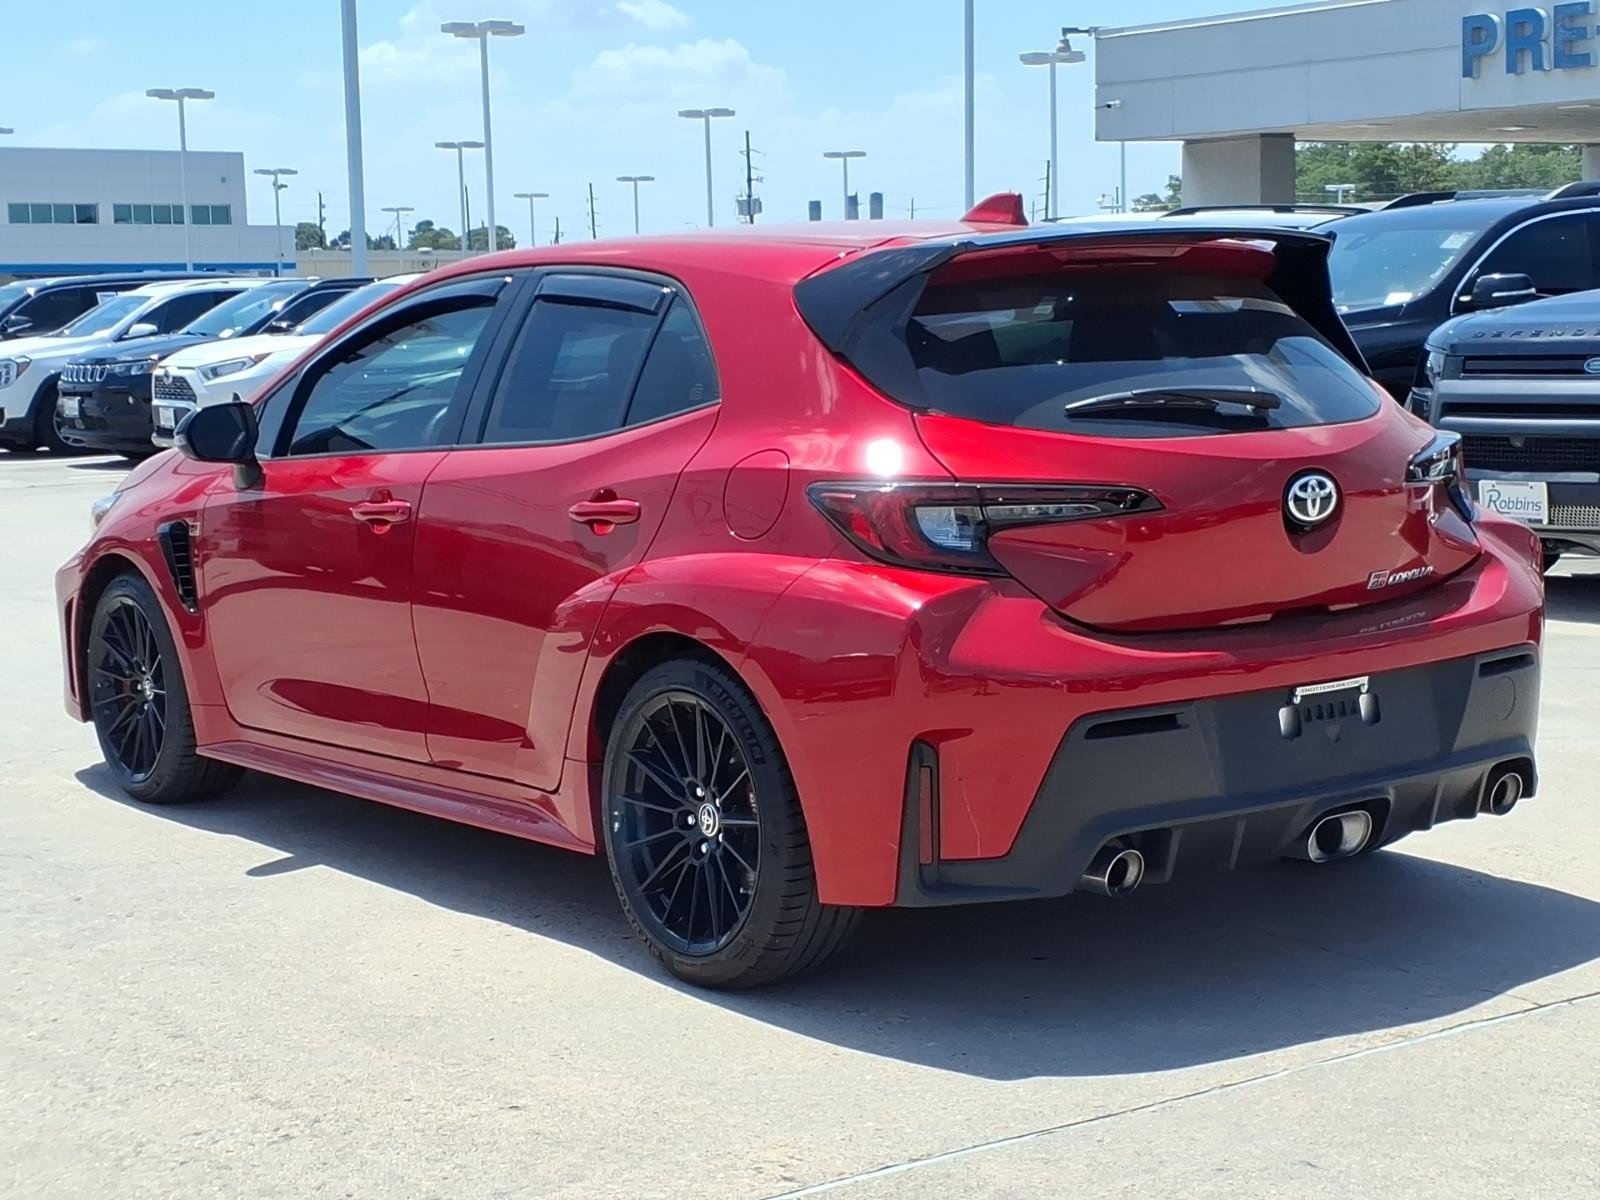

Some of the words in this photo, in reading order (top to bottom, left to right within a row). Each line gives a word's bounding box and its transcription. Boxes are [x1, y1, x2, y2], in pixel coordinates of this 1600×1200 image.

[1462, 1, 1600, 79] PRE
[1486, 489, 1542, 514] Robbins
[1388, 565, 1434, 584] COROLLA
